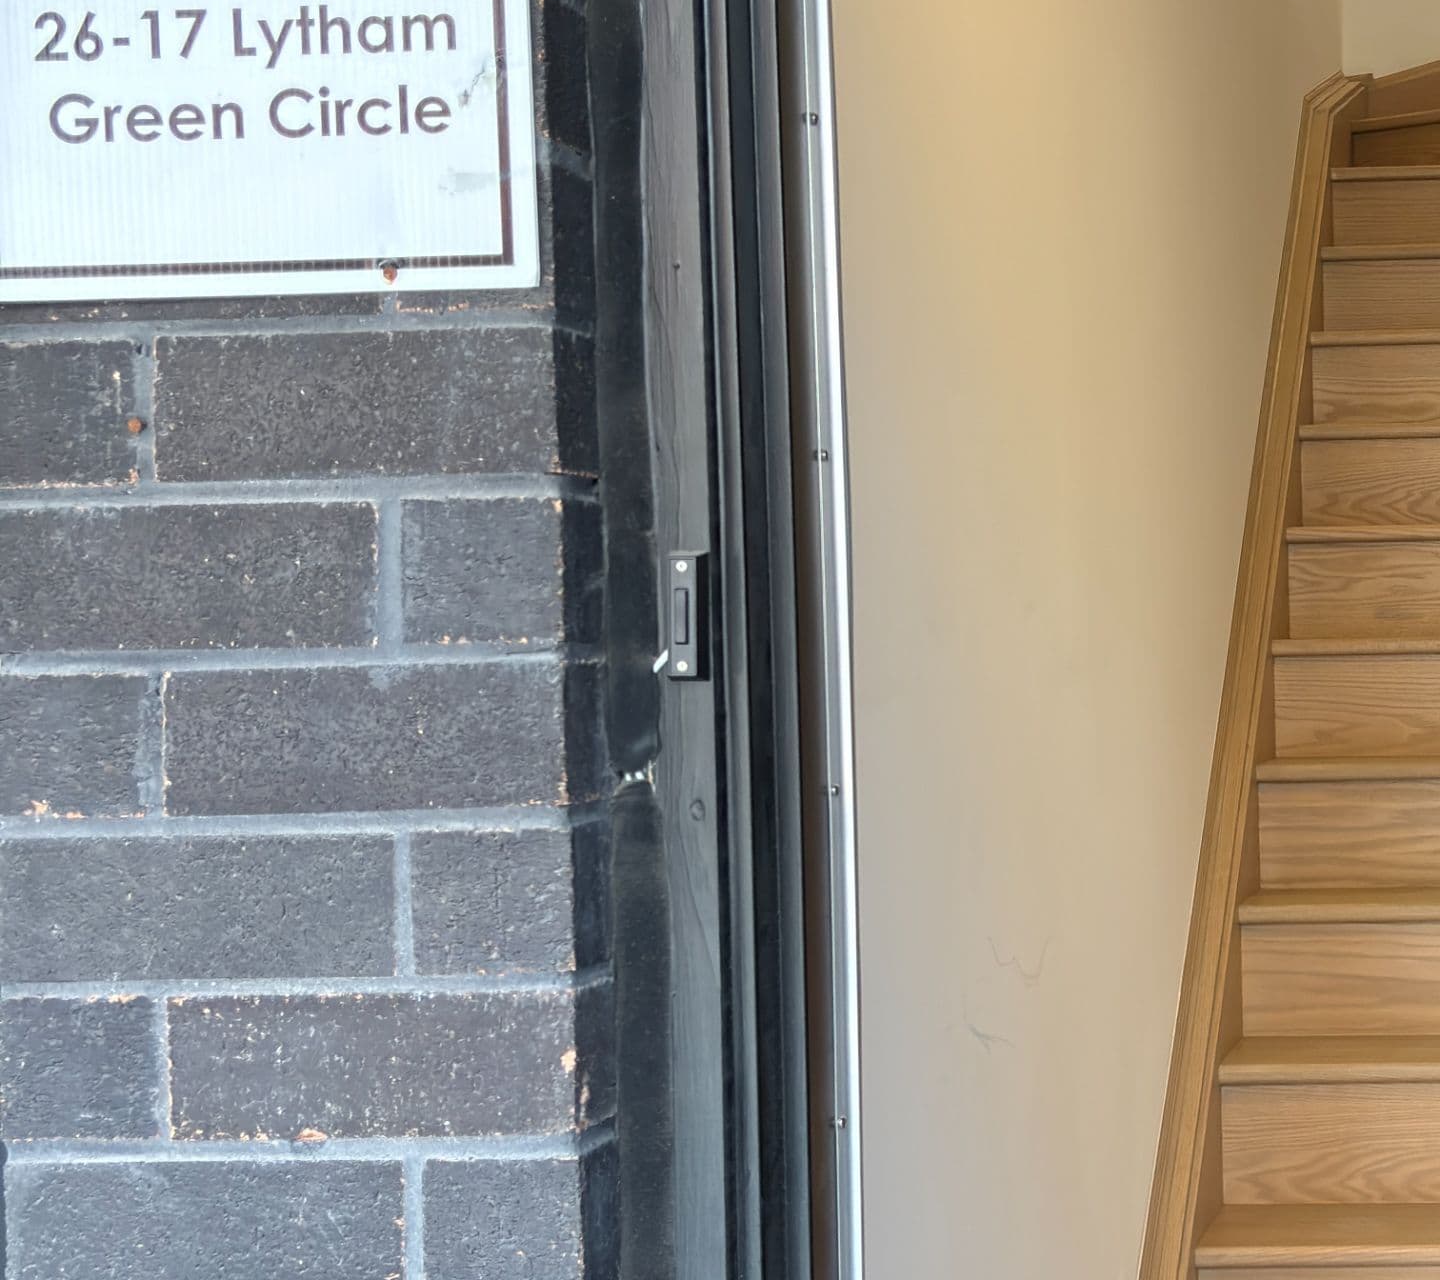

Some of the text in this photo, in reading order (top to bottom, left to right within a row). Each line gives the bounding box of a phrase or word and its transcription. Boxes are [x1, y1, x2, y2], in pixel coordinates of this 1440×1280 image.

[34, 4, 456, 69] 26-17 Lytham
[49, 84, 452, 144] Green Circle
